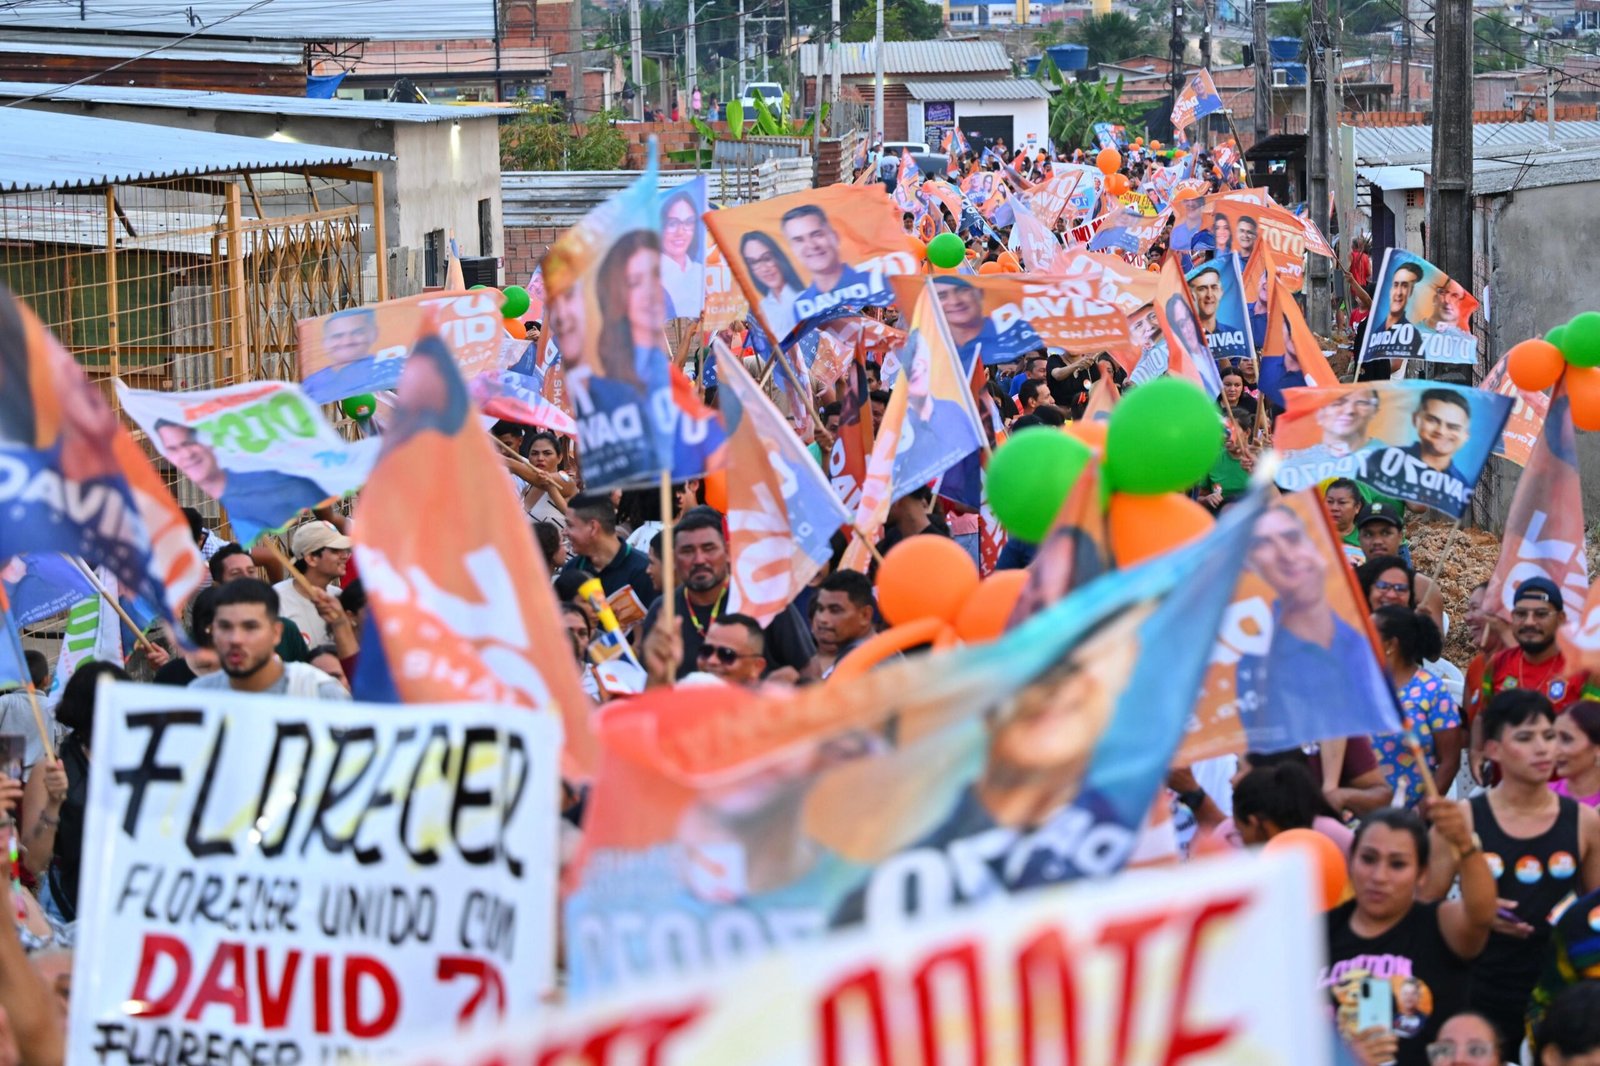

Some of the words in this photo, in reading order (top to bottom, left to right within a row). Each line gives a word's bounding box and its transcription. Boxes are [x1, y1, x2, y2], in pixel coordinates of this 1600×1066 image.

[1259, 224, 1303, 258] 7070
[795, 282, 869, 319] DAVID
[991, 296, 1116, 335] DAVID
[113, 708, 530, 878] FLORECER
[317, 884, 437, 947] UNIDO
[122, 933, 403, 1040] DAVID
